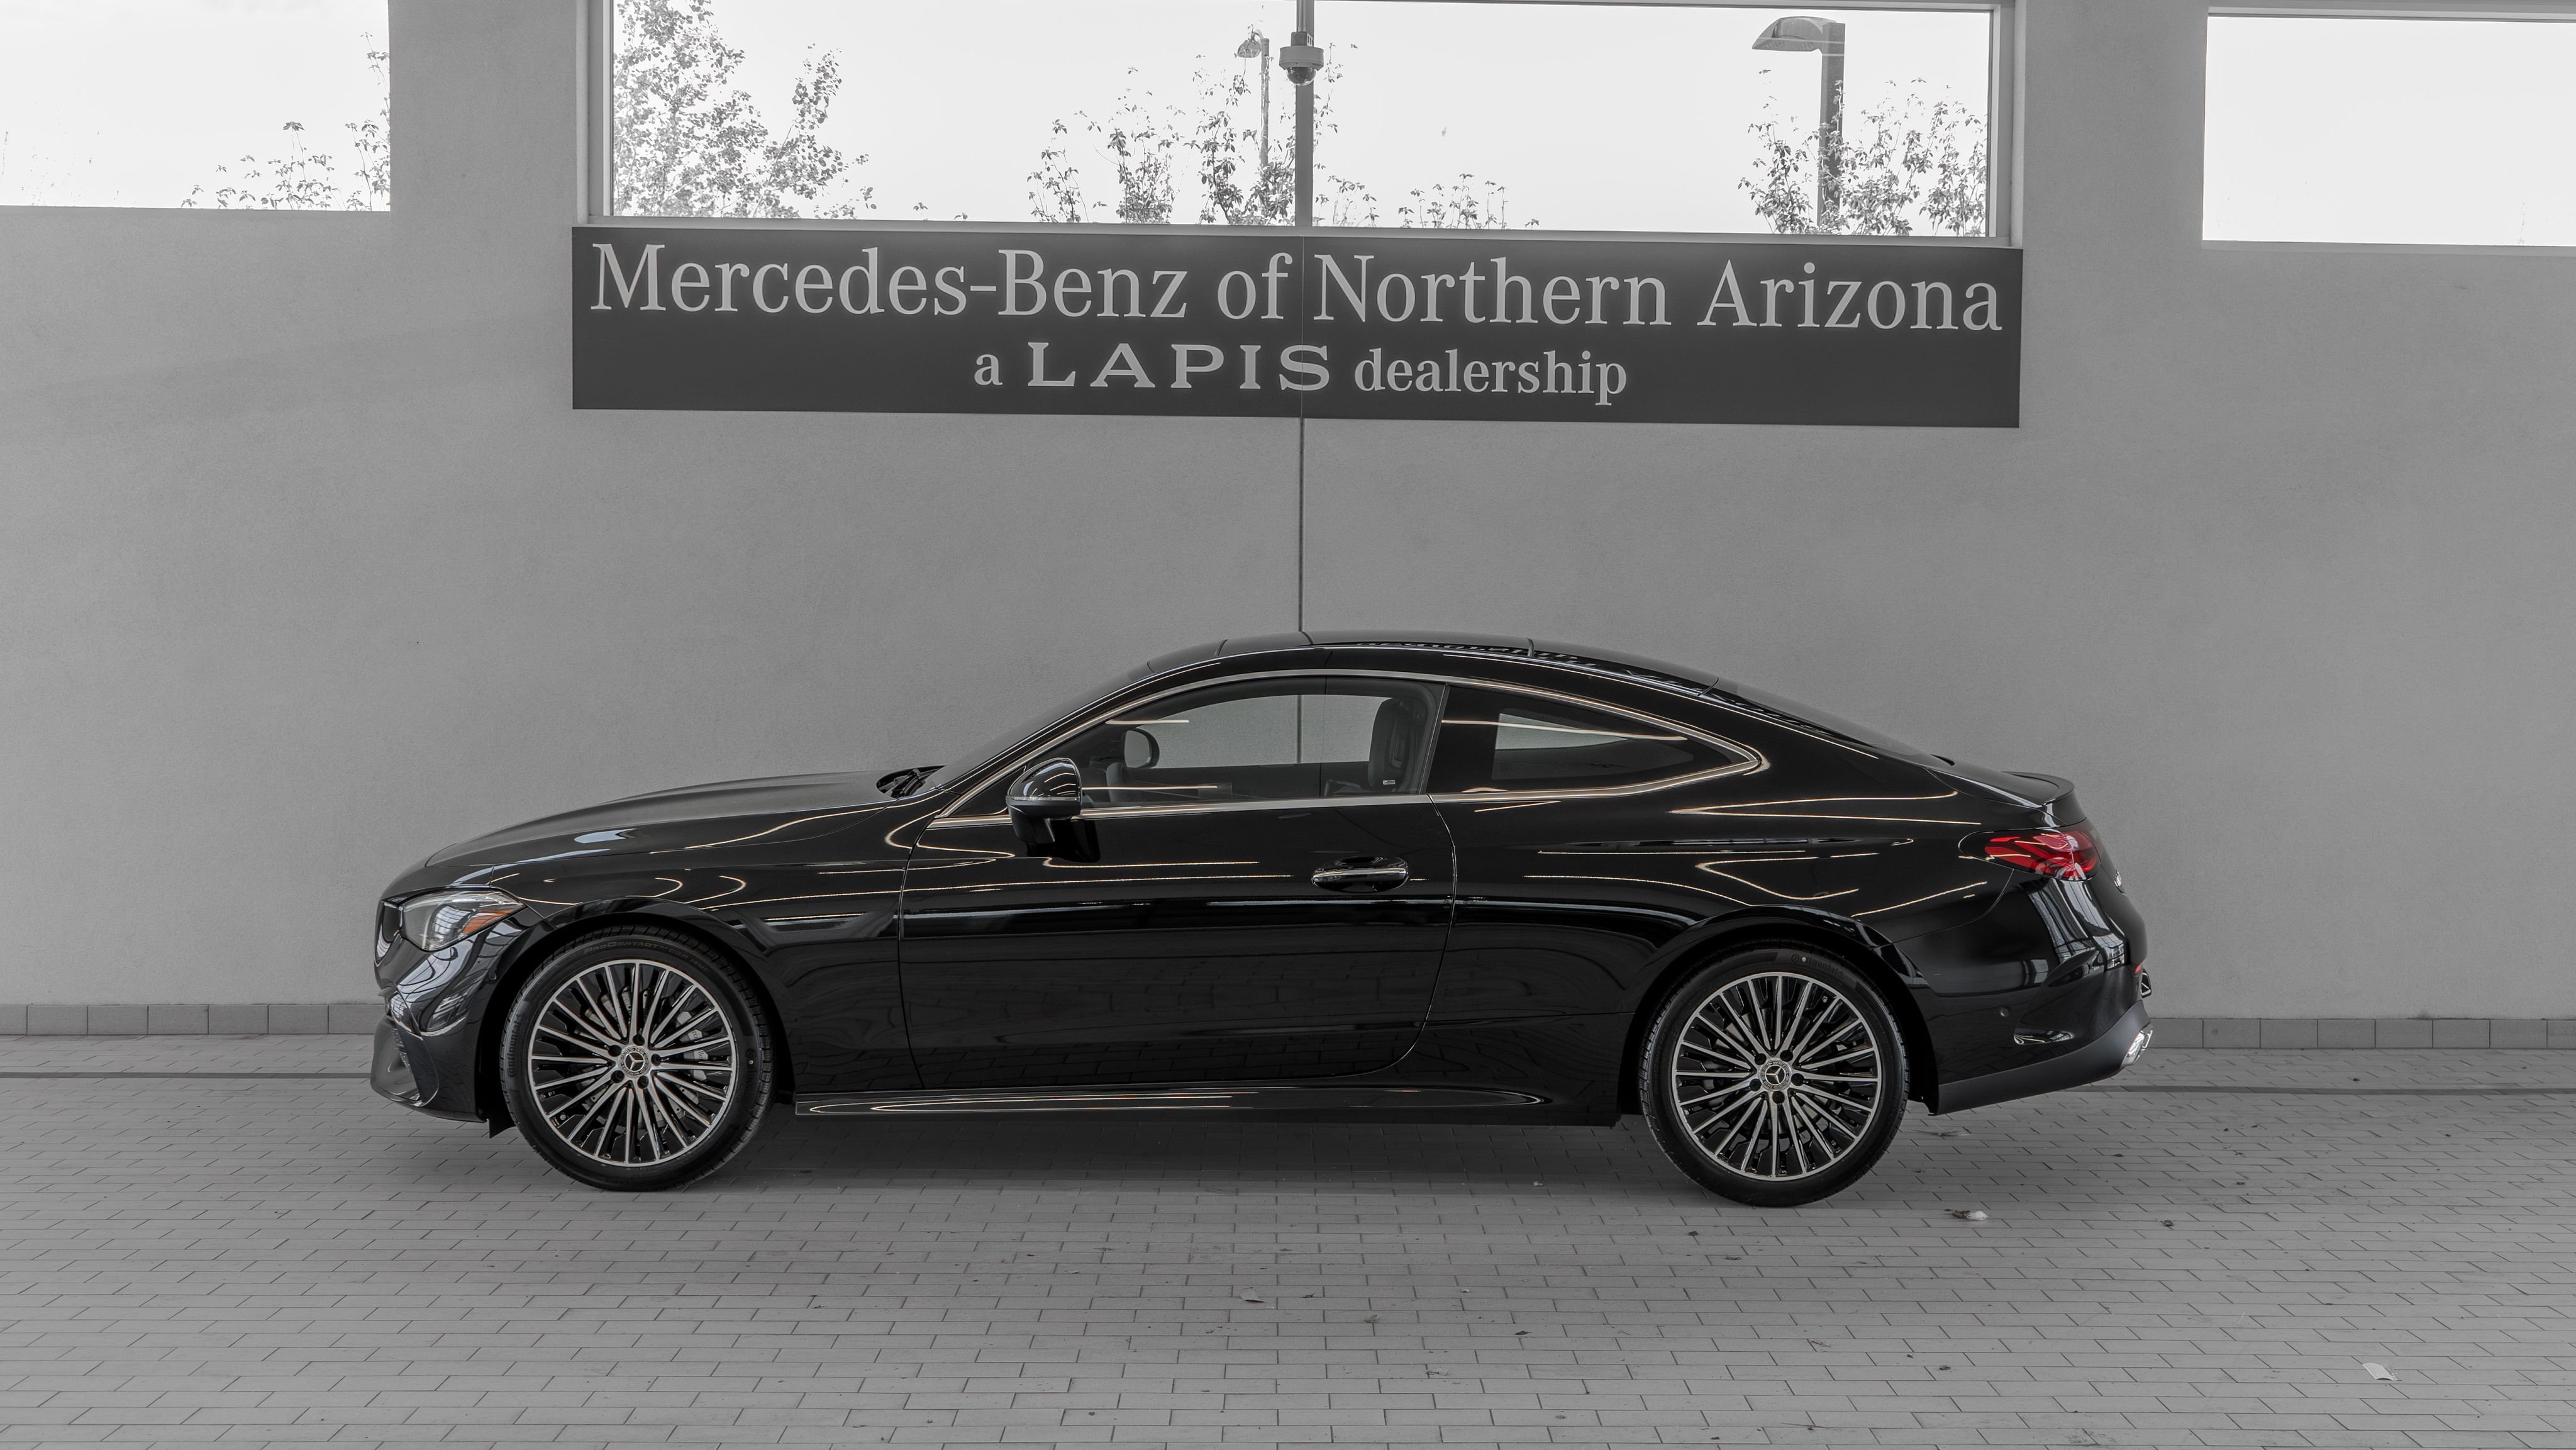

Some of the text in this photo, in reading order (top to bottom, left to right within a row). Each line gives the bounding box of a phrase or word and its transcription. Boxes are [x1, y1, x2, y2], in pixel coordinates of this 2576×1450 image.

[590, 243, 2003, 331] Mercedes-Benz of Northern Arizona
[974, 342, 1627, 406] a LAPIS dealership
